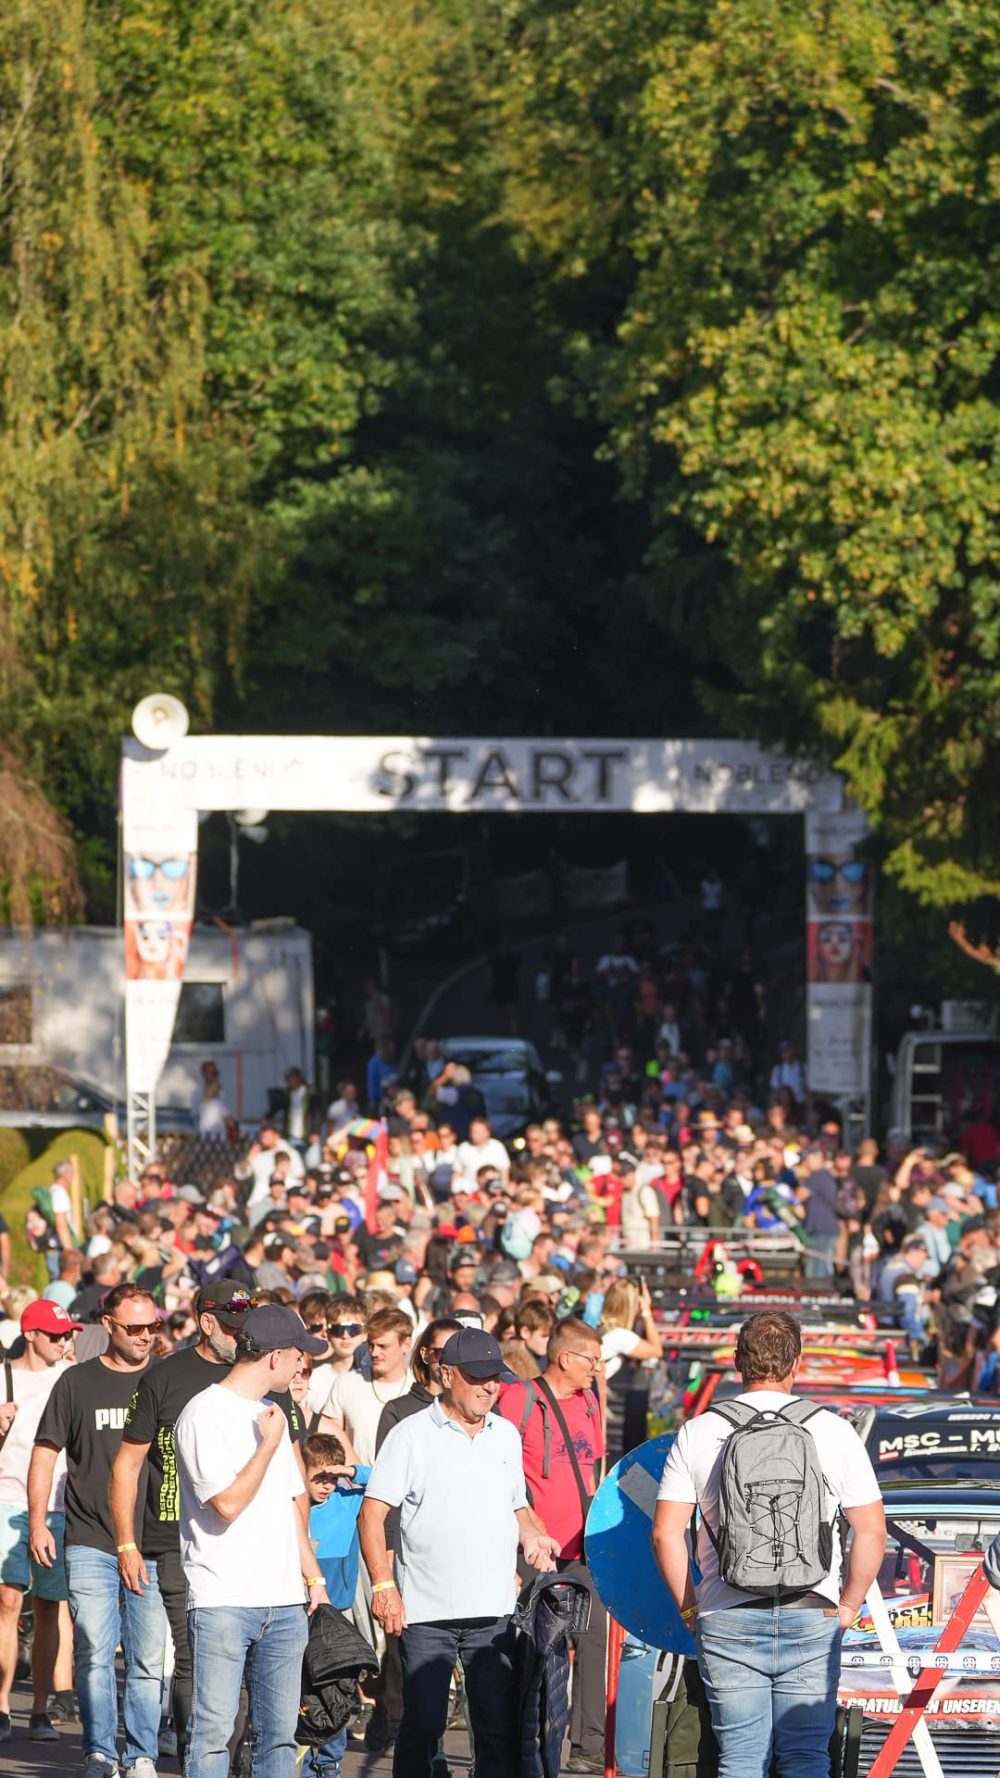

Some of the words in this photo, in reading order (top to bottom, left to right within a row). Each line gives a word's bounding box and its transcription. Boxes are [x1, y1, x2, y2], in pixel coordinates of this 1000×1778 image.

[376, 749, 626, 801] START
[95, 1408, 129, 1430] PU
[880, 1432, 941, 1454] MSC
